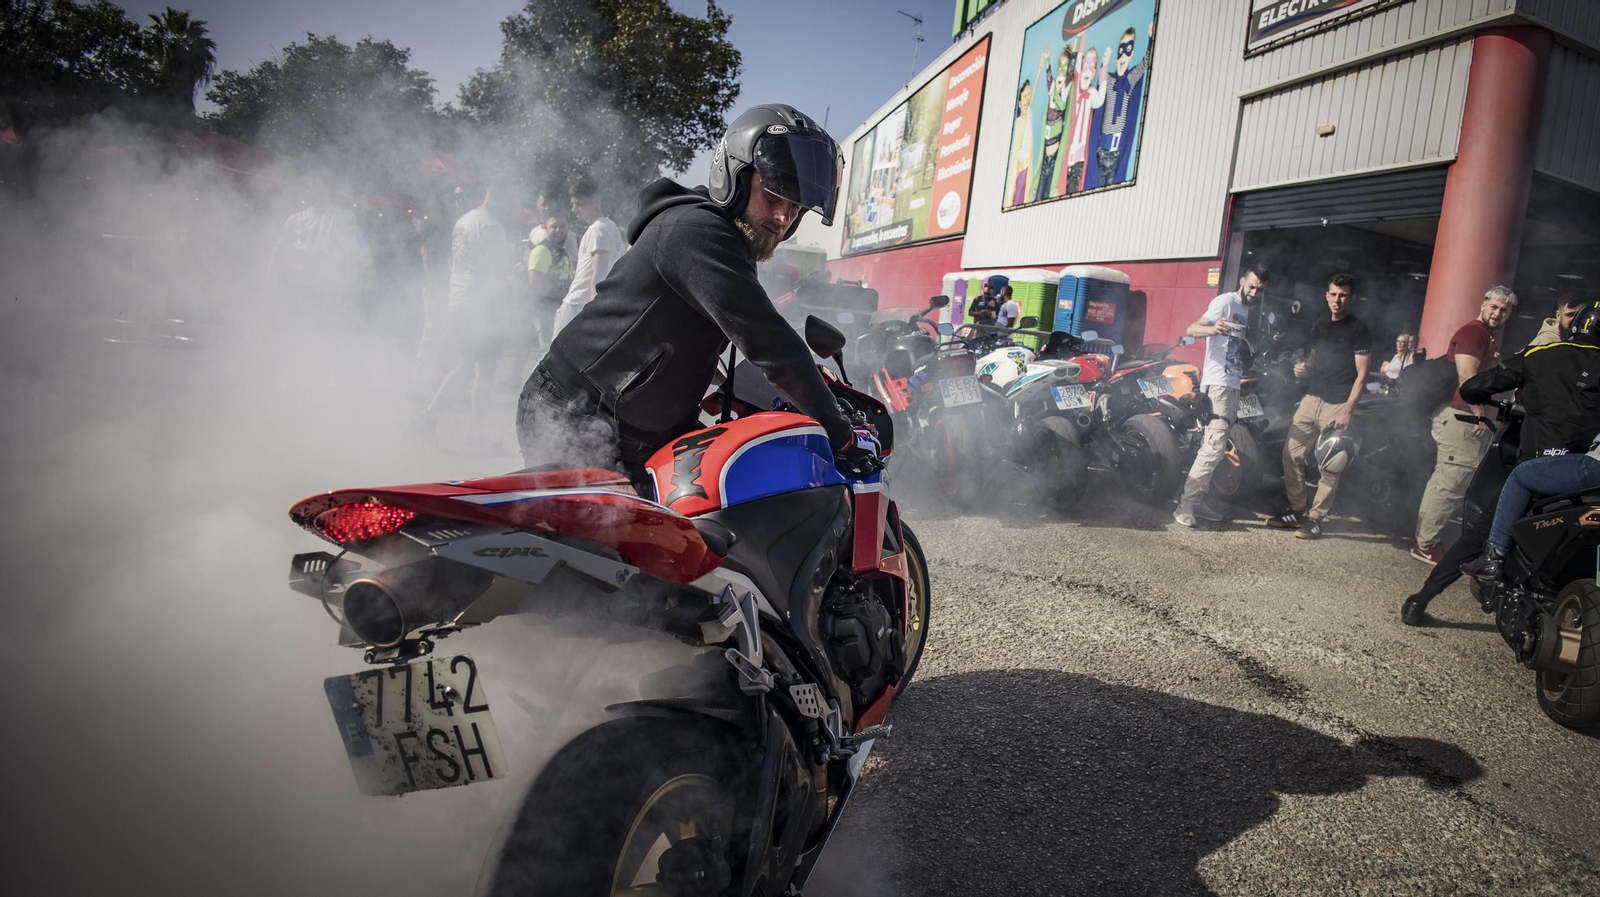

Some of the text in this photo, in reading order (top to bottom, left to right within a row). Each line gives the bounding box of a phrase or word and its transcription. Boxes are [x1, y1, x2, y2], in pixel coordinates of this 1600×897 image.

[1258, 0, 1328, 29] ELECTR
[952, 388, 980, 404] 2131
[360, 655, 489, 728] 7742
[393, 722, 493, 788] FSH
